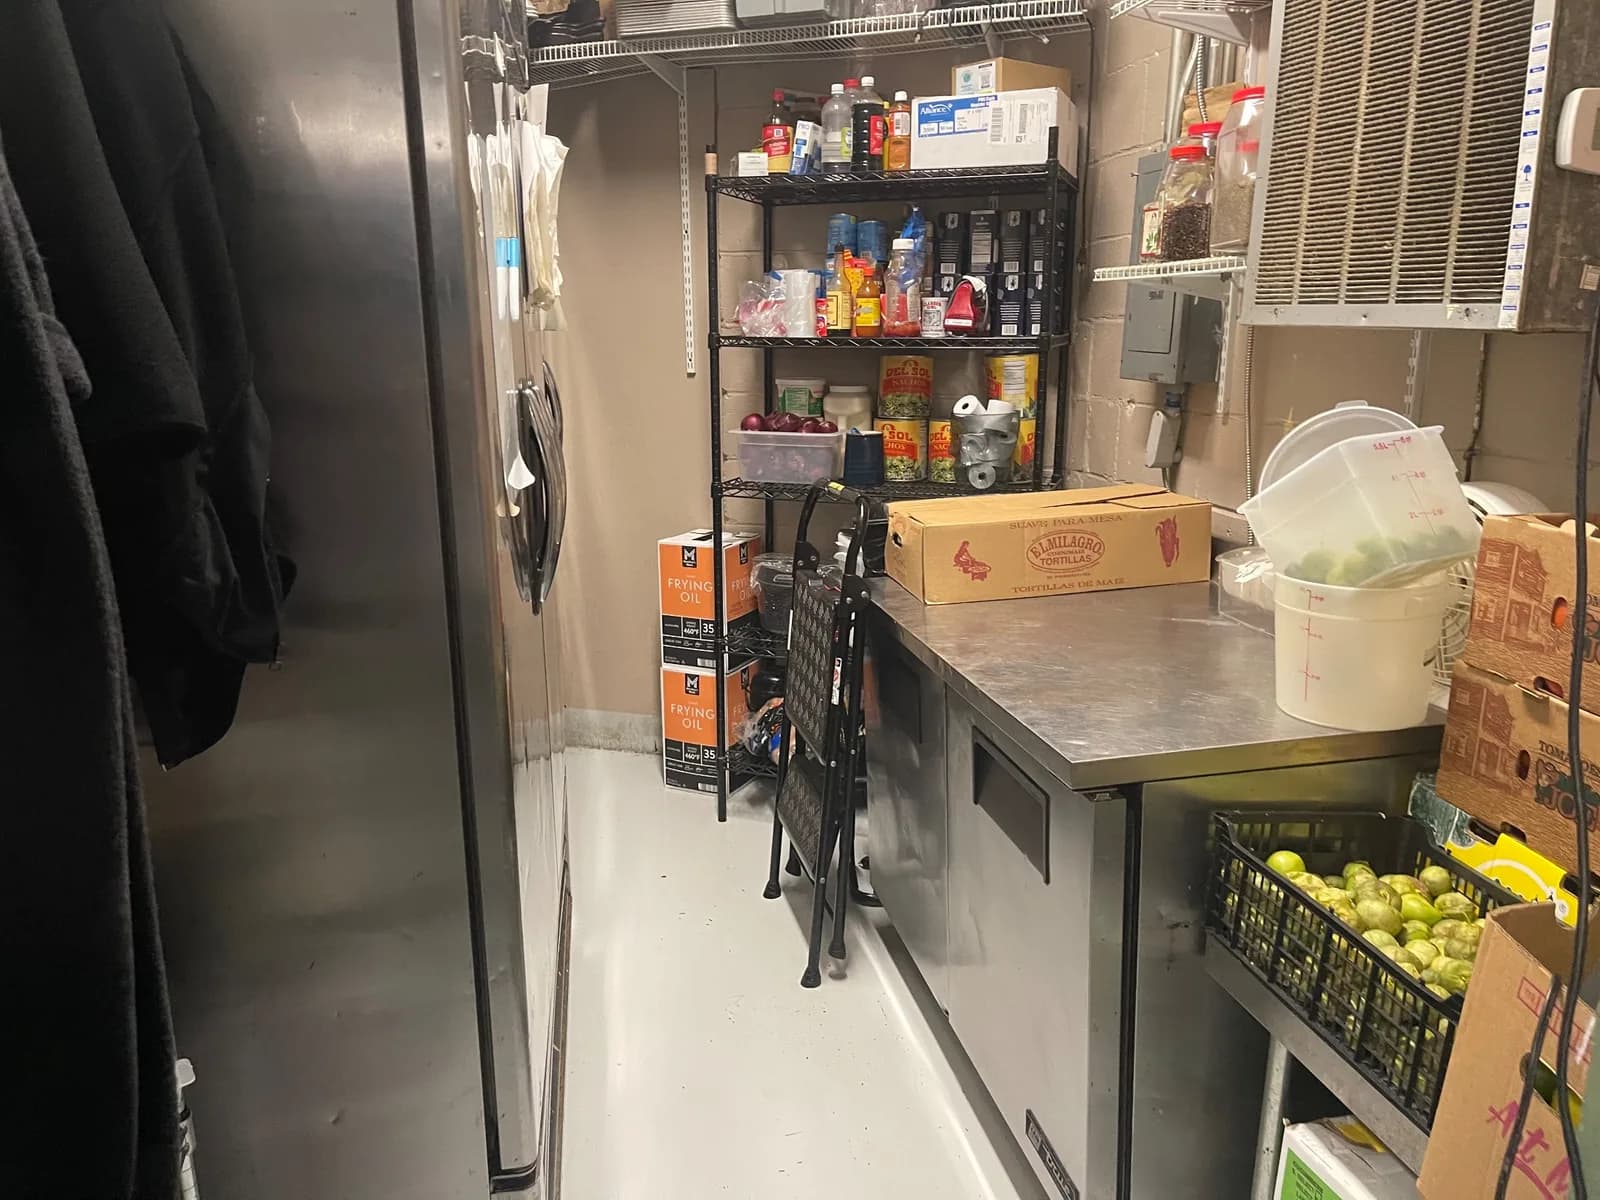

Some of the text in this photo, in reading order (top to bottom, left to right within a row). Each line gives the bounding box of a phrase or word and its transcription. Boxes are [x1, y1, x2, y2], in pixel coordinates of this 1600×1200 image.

[886, 367, 931, 378] DEL SOL
[889, 431, 913, 442] SOL
[1009, 515, 1122, 530] SUAVE PARA MESA
[1039, 554, 1092, 566] TORTILLAS
[668, 578, 713, 592] FRYING
[1012, 582, 1074, 593] TORTILLAS
[1078, 580, 1093, 588] DE
[680, 592, 702, 604] OIL
[702, 623, 714, 634] 35
[670, 704, 715, 720] FRYING
[682, 718, 703, 730] OIL
[703, 749, 716, 760] 35
